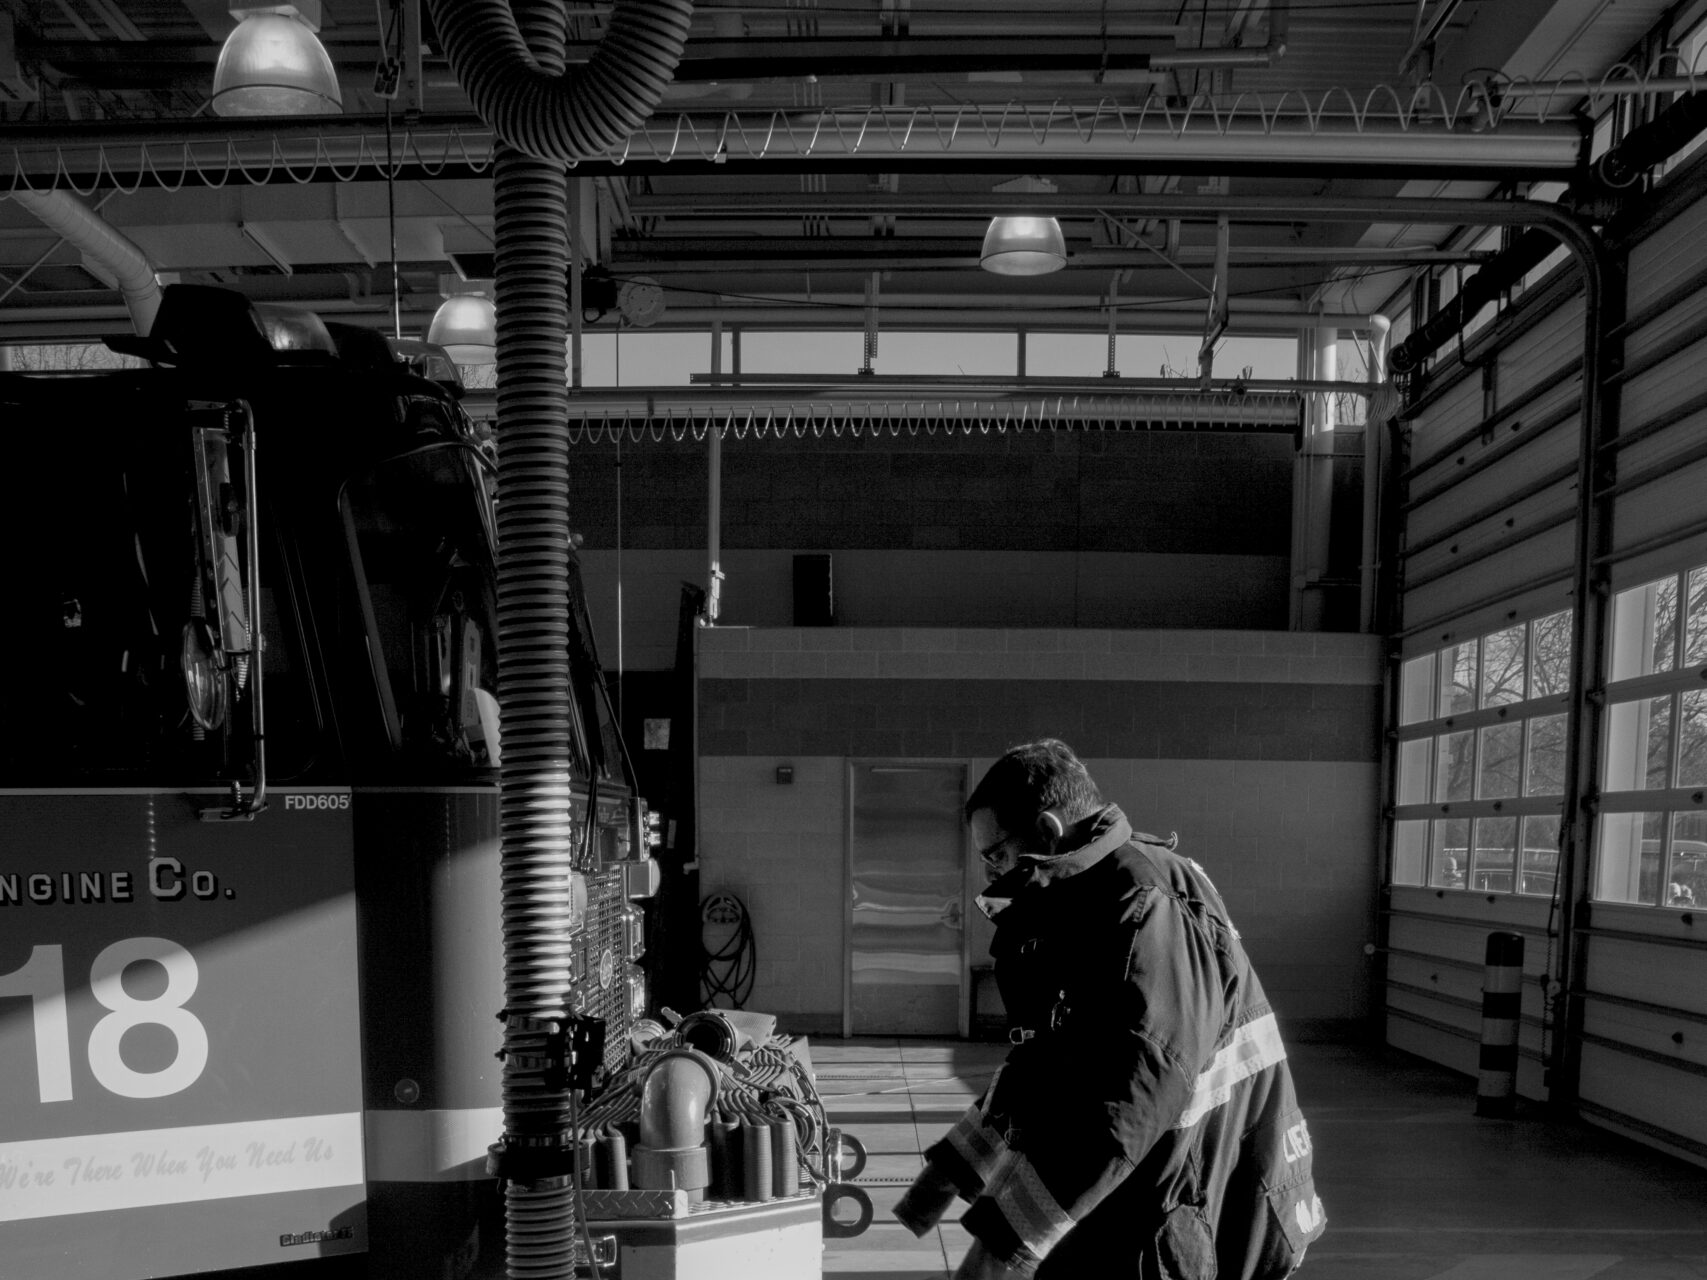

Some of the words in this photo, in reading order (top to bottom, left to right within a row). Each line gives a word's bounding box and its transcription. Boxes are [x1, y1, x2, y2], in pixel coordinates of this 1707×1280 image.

[285, 795, 349, 810] FDD605
[148, 857, 236, 900] Co.
[0, 936, 209, 1104] 18
[0, 1160, 55, 1190] We're
[63, 1155, 122, 1186] There
[130, 1149, 188, 1179] When
[195, 1145, 238, 1182] You
[245, 1140, 297, 1169] Need
[303, 1136, 335, 1163] Us
